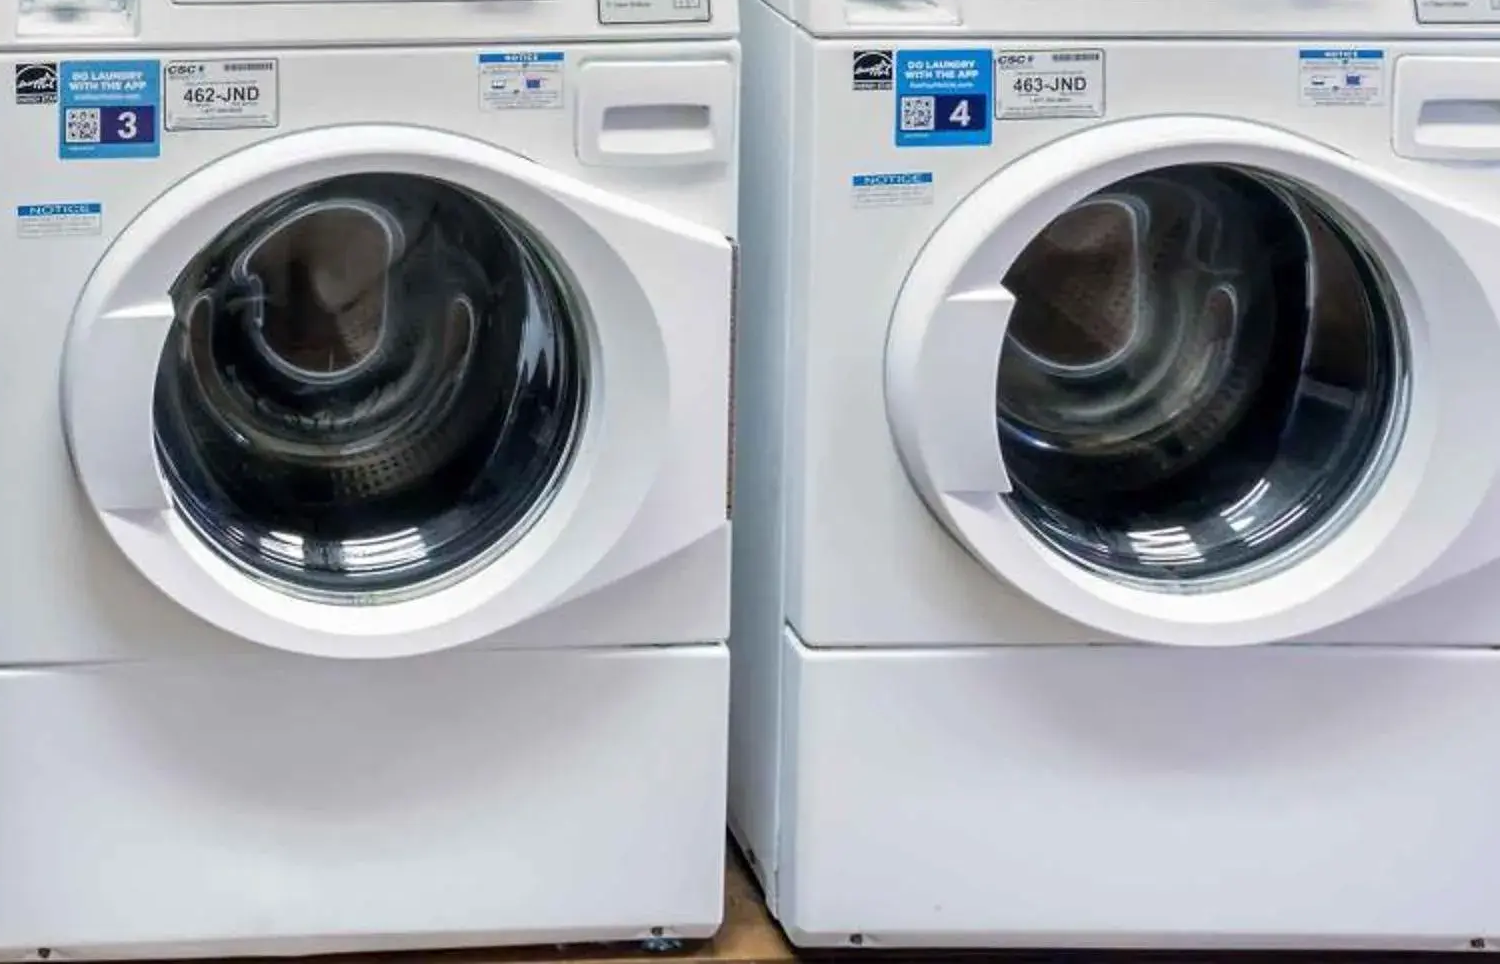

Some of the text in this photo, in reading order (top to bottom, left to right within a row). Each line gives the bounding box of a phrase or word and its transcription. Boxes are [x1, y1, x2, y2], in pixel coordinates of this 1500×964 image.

[925, 59, 976, 69] LAUNDRY
[91, 70, 143, 81] LAUNDRY
[167, 65, 197, 75] CSC
[904, 69, 979, 80] WITH THE APP
[68, 81, 147, 91] WITH THE APP
[1013, 76, 1087, 93] 463-JND
[183, 85, 260, 103] 462-JND
[949, 99, 971, 127] 4
[117, 111, 137, 139] 3
